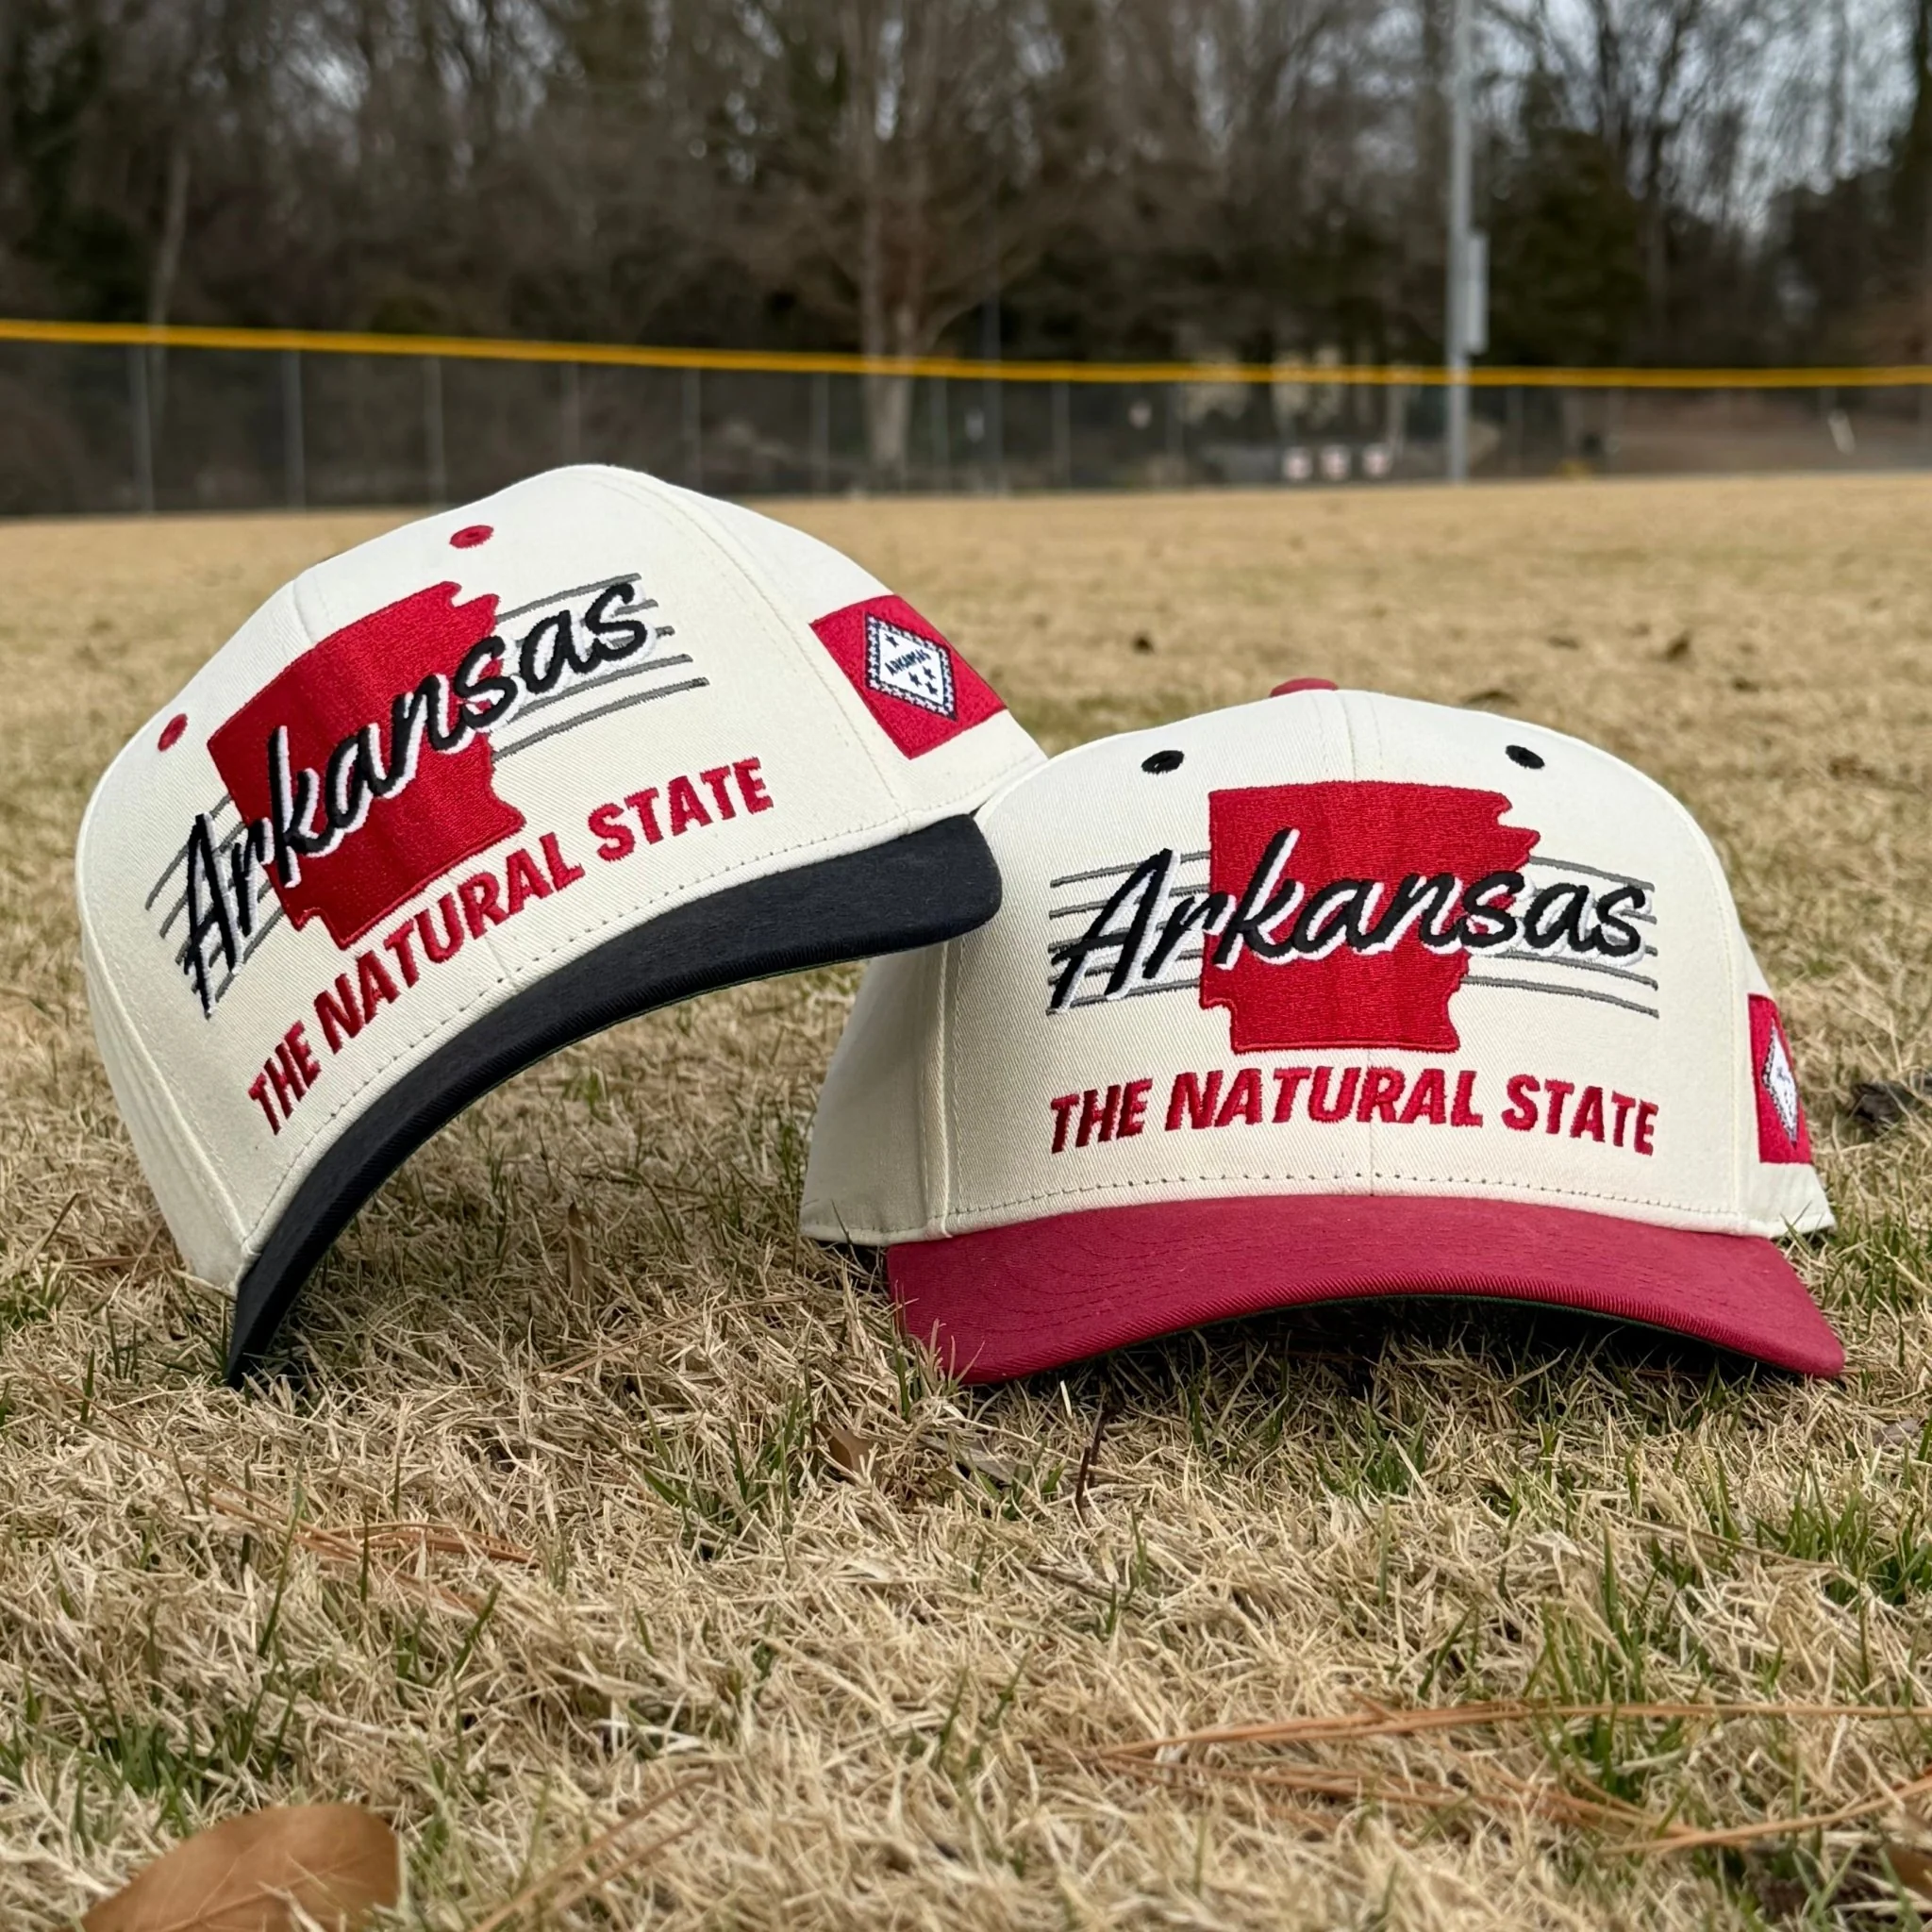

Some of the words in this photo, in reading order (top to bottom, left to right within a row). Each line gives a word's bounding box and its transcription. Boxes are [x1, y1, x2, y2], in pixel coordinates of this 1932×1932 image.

[182, 581, 654, 1020] Arkansas
[1046, 828, 1651, 1013] Arkansas
[248, 1021, 321, 1135] THE
[313, 833, 585, 1056] NATURAL
[588, 758, 774, 862] STATE
[1051, 1077, 1153, 1153] THE
[1165, 1066, 1484, 1131] NATURAL
[1501, 1074, 1659, 1156] STATE
